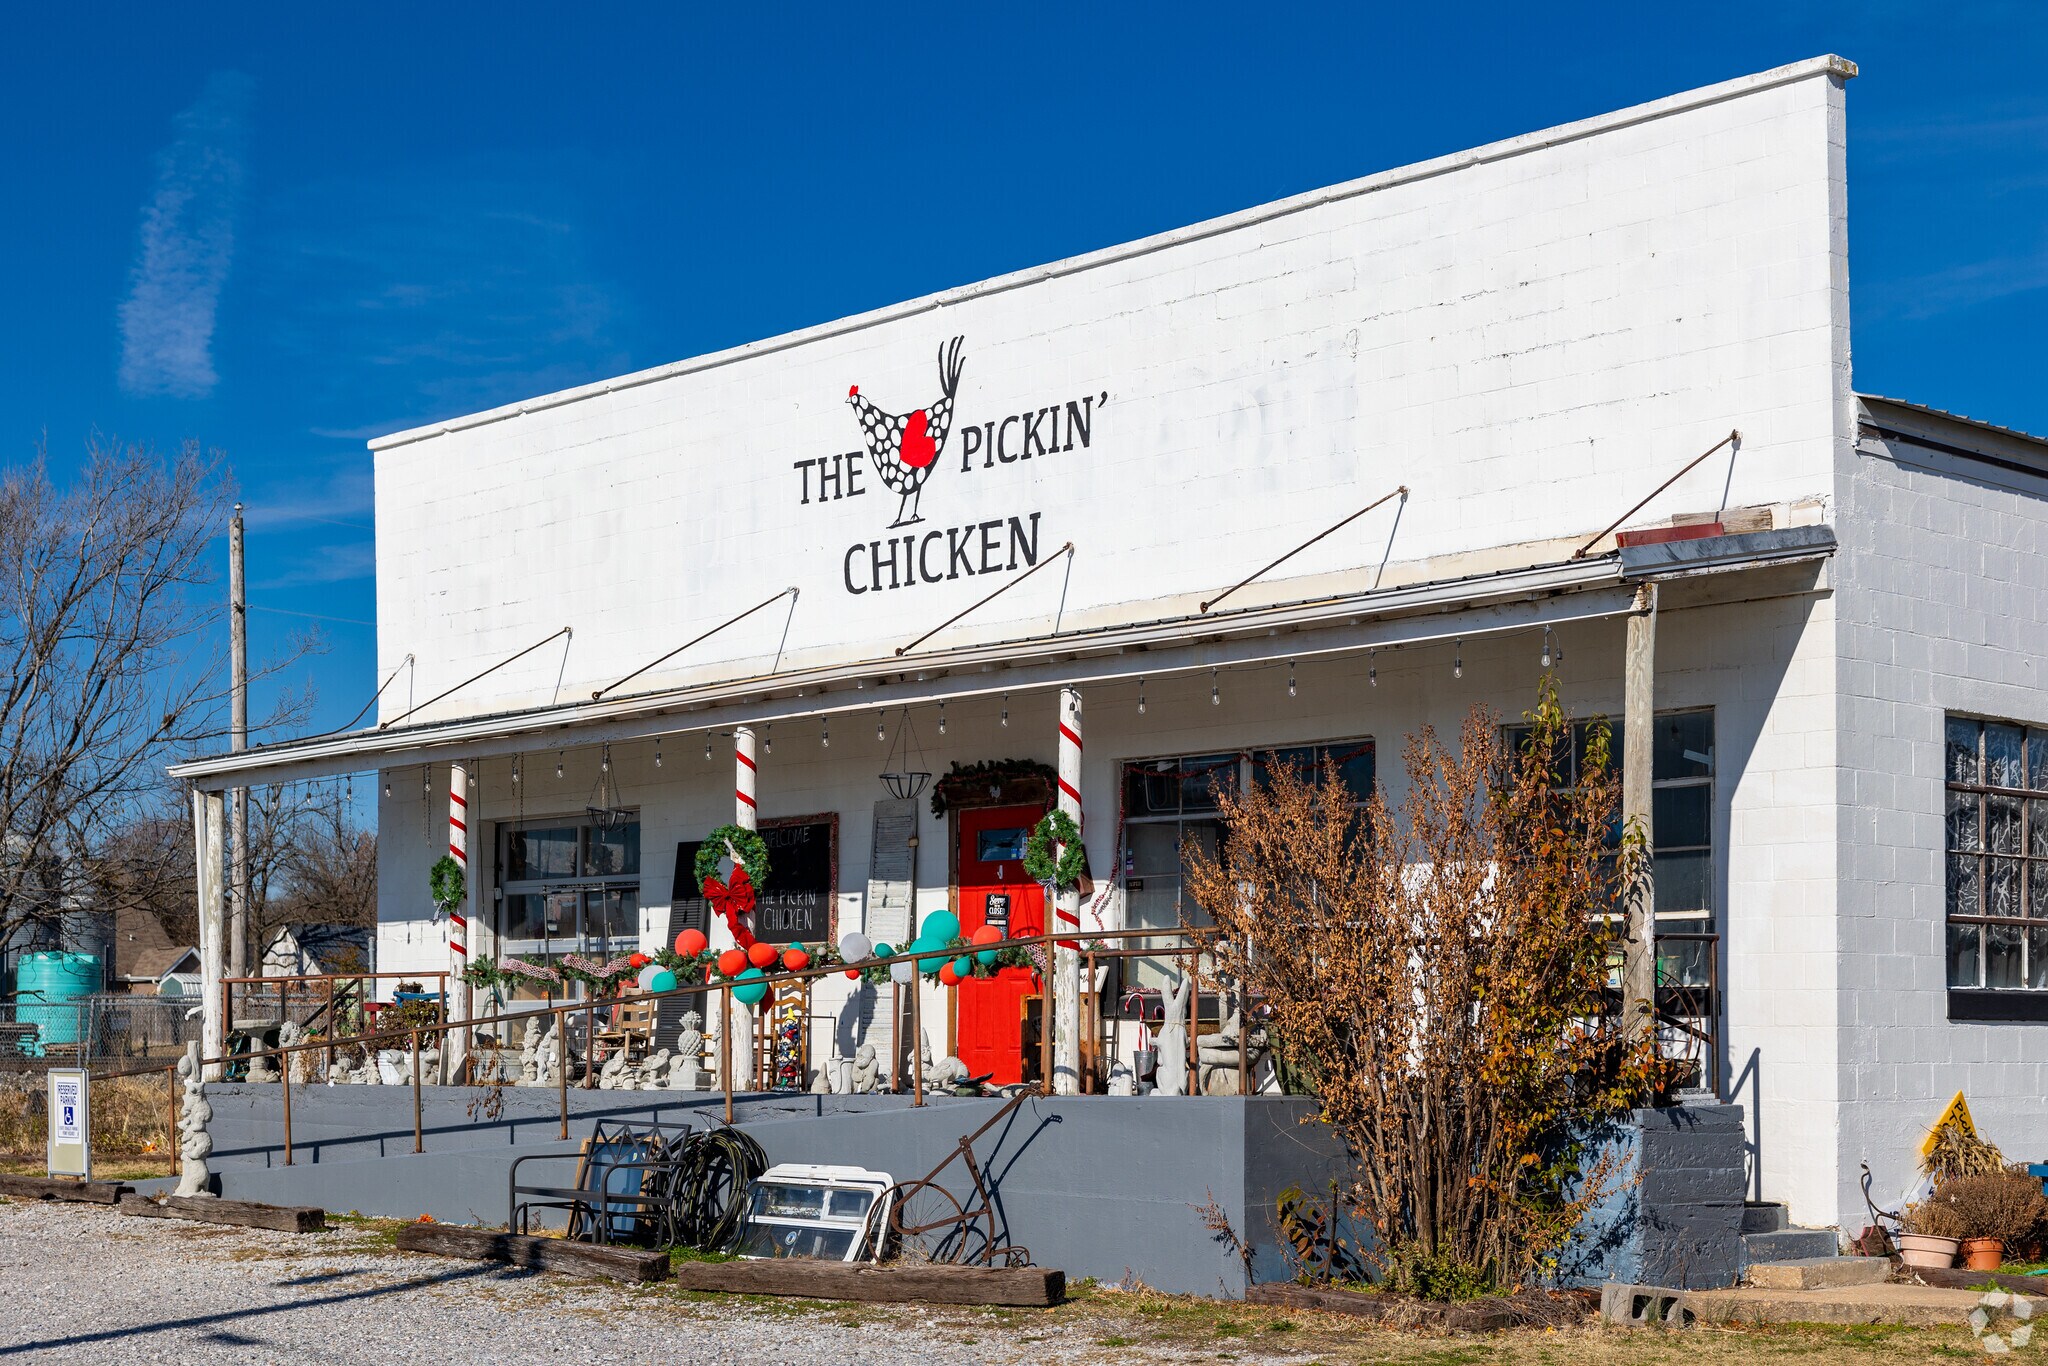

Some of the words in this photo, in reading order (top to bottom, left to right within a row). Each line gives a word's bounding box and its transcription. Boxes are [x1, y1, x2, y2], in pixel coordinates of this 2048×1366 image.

[794, 451, 866, 504] THE
[961, 391, 1108, 473] PICKIN'
[844, 511, 1041, 594] CHICKEN
[762, 827, 810, 848] WELCOME
[762, 889, 775, 905] THE
[763, 907, 812, 931] CHICKEN
[989, 907, 1005, 915] CLOSED
[58, 1085, 77, 1095] RESERVED
[60, 1095, 76, 1105] PARKING
